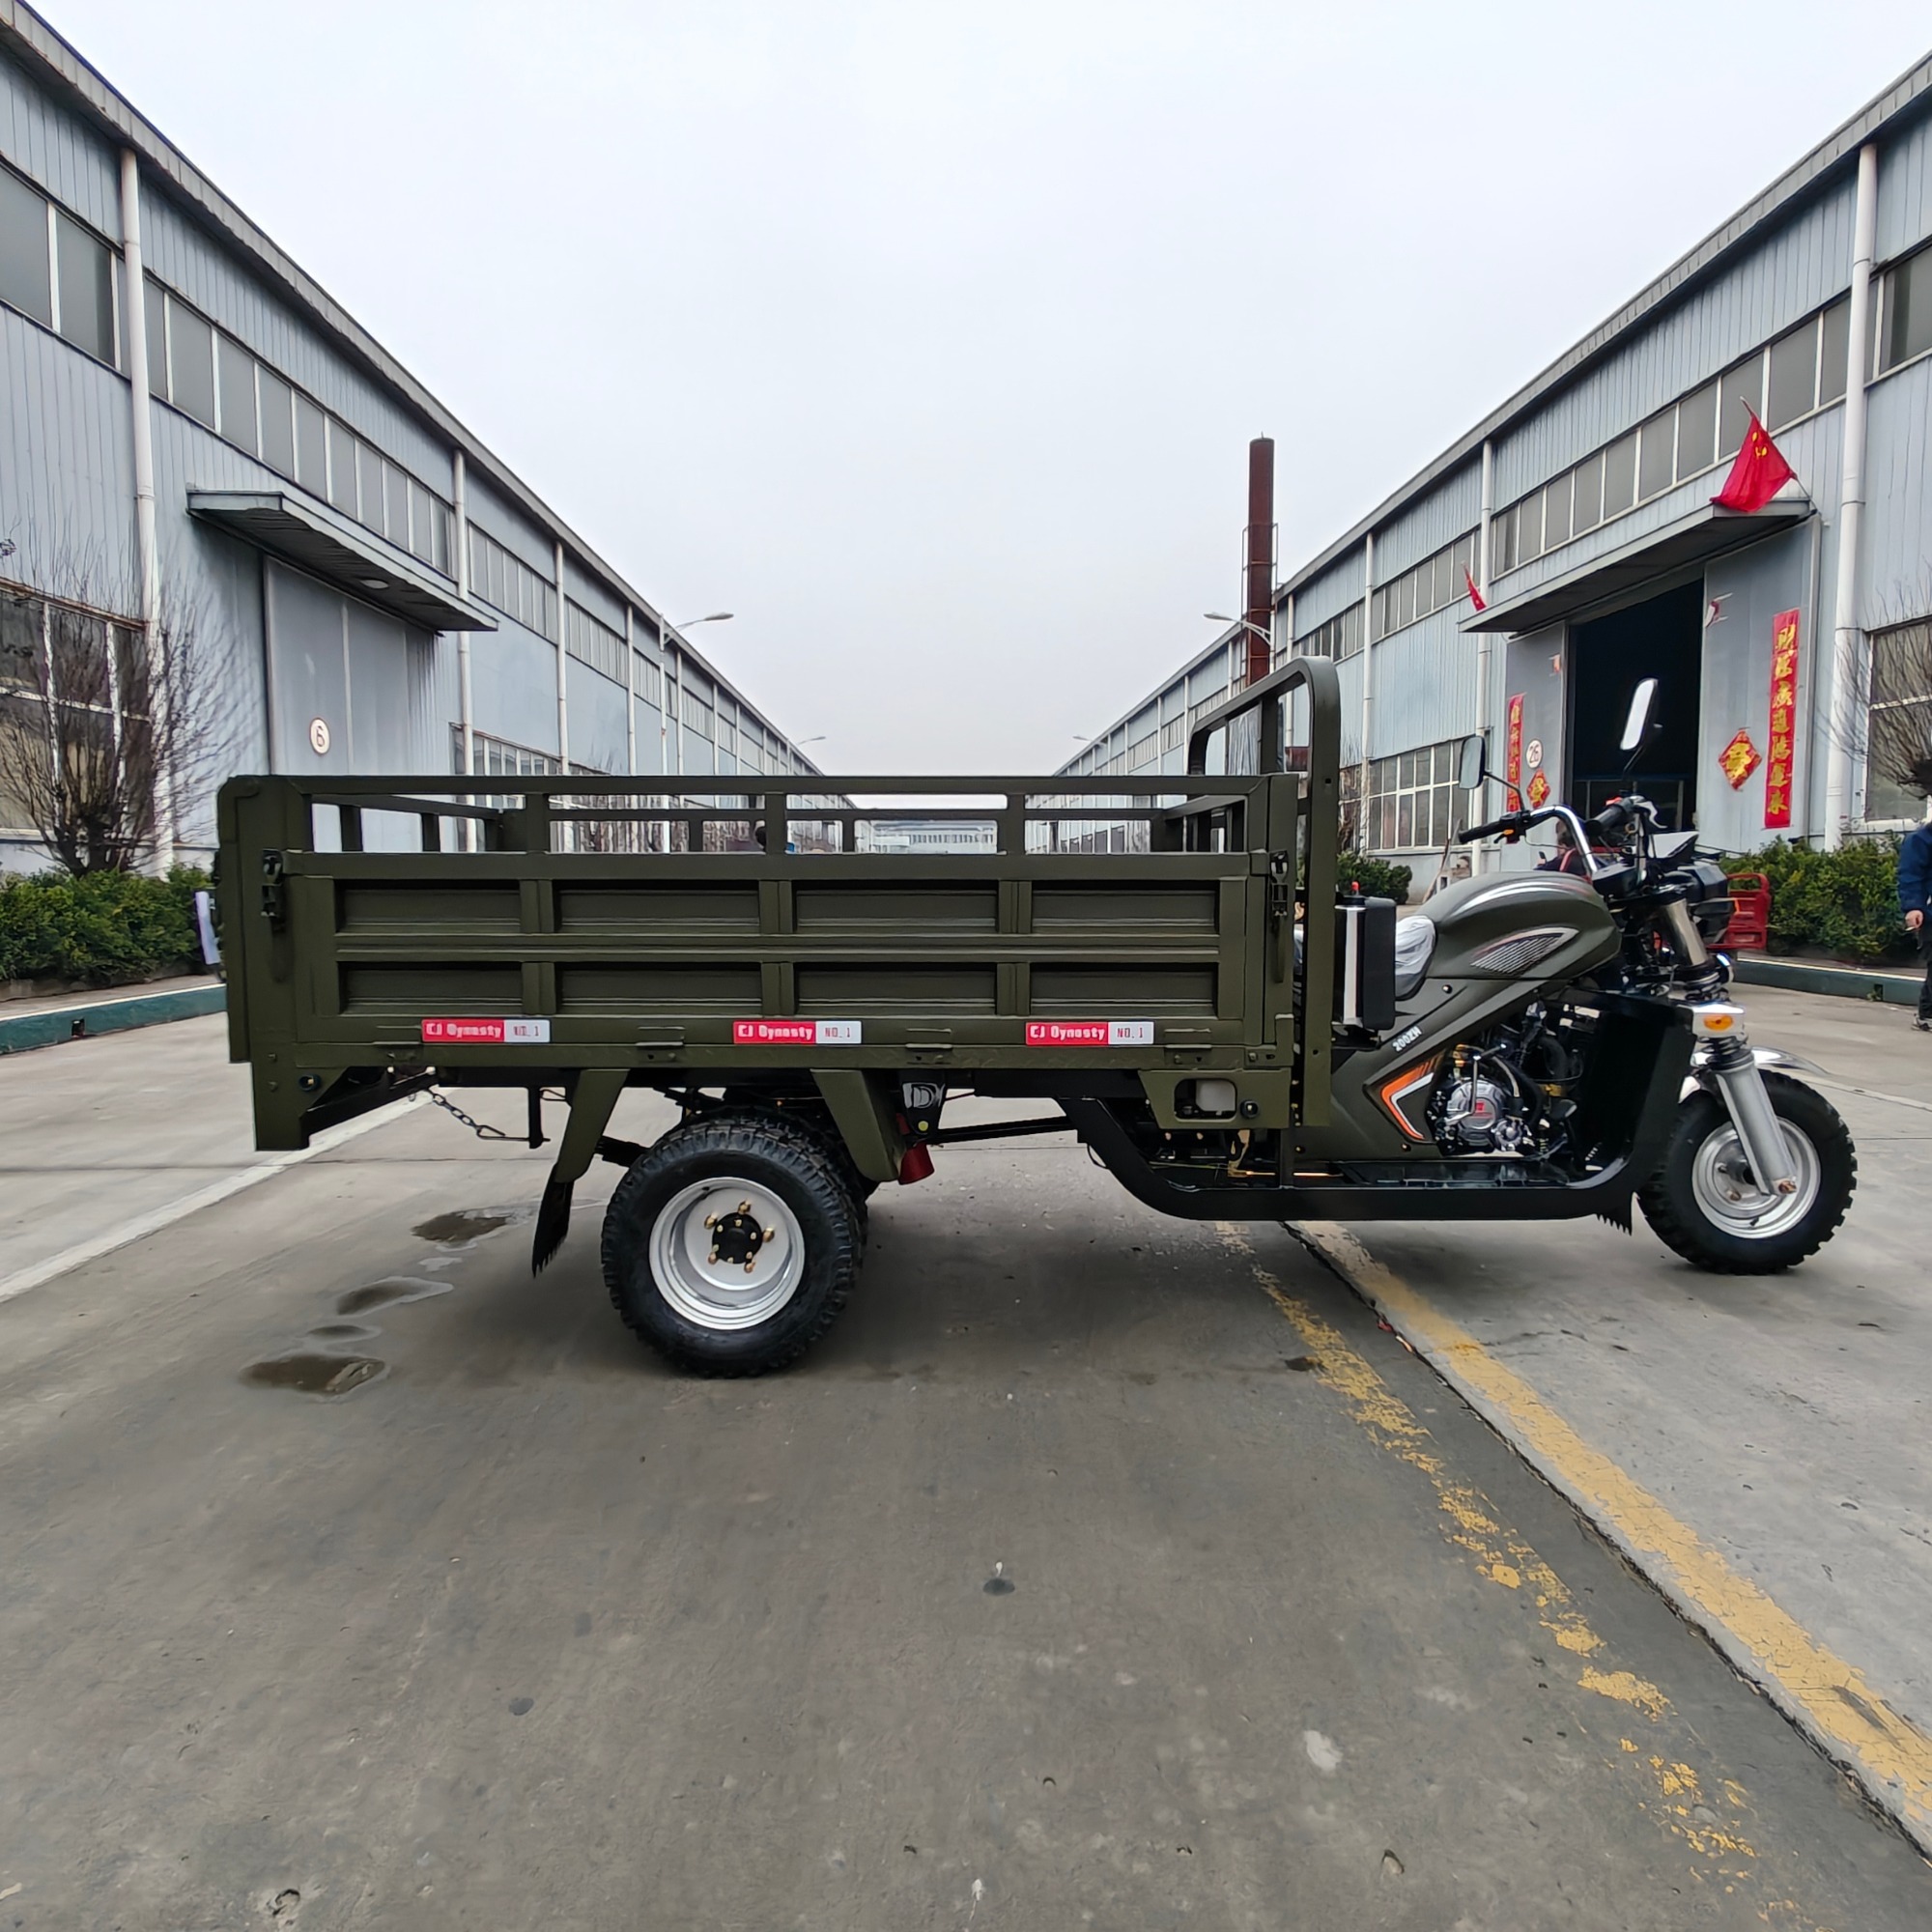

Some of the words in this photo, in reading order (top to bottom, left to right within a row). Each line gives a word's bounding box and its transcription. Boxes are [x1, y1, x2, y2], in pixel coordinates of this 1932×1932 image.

[316, 724, 326, 748] 6
[1528, 743, 1541, 764] 26
[446, 1023, 501, 1038] Dynasty
[758, 1025, 813, 1040] Dynasty
[1050, 1025, 1105, 1041] Dynasty
